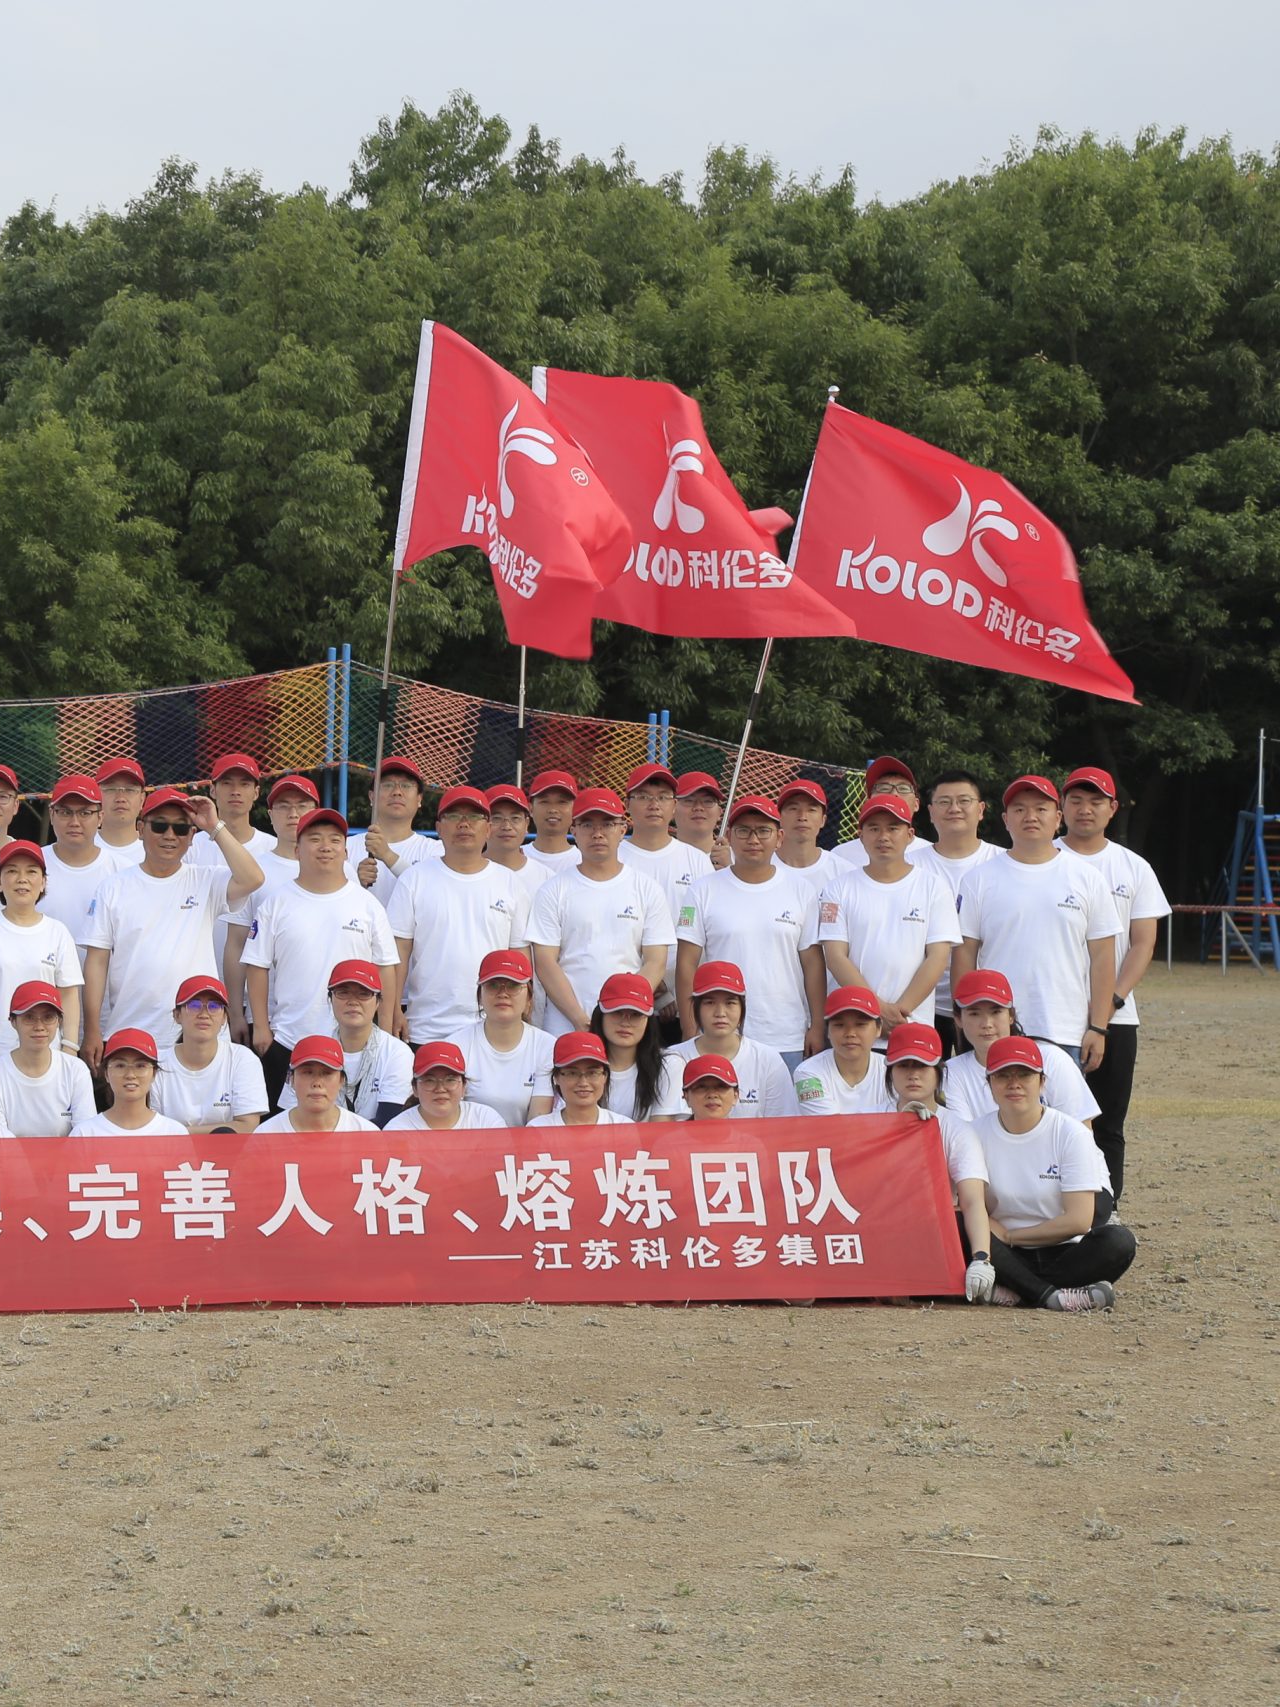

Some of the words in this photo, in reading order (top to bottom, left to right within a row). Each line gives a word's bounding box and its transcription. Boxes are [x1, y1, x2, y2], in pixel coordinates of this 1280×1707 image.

[687, 549, 794, 589] 科伦多
[836, 535, 983, 618] KOLOD
[984, 596, 1081, 663] 科伦多
